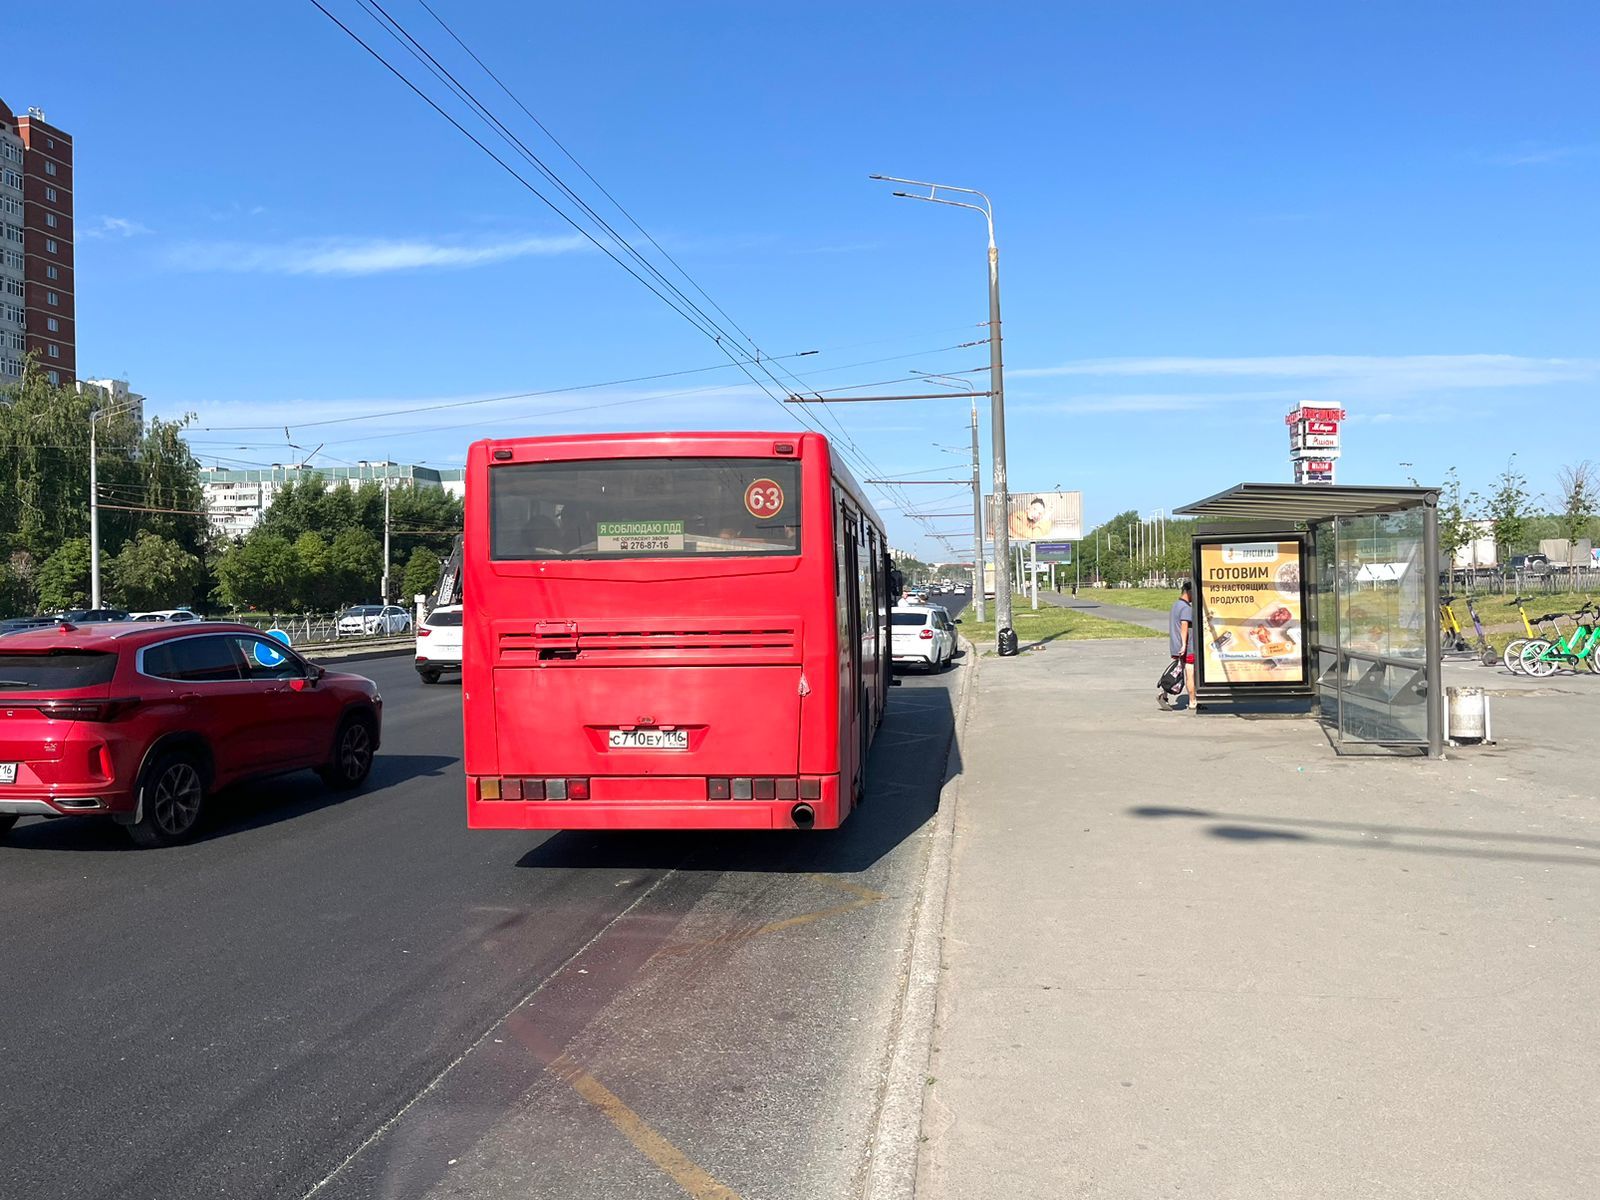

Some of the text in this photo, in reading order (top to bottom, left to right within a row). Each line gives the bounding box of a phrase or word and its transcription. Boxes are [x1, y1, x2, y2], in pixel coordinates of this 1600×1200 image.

[750, 487, 780, 509] 63
[601, 523, 681, 533] Я СОБЛЮДАЮ ПДД
[630, 541, 668, 549] 276-87-16
[1209, 566, 1269, 580] ГОТОВИМ
[1210, 583, 1269, 592] ИЗ НАСТОЯЩИХ
[1210, 595, 1255, 605] ПРОДУКТОВ
